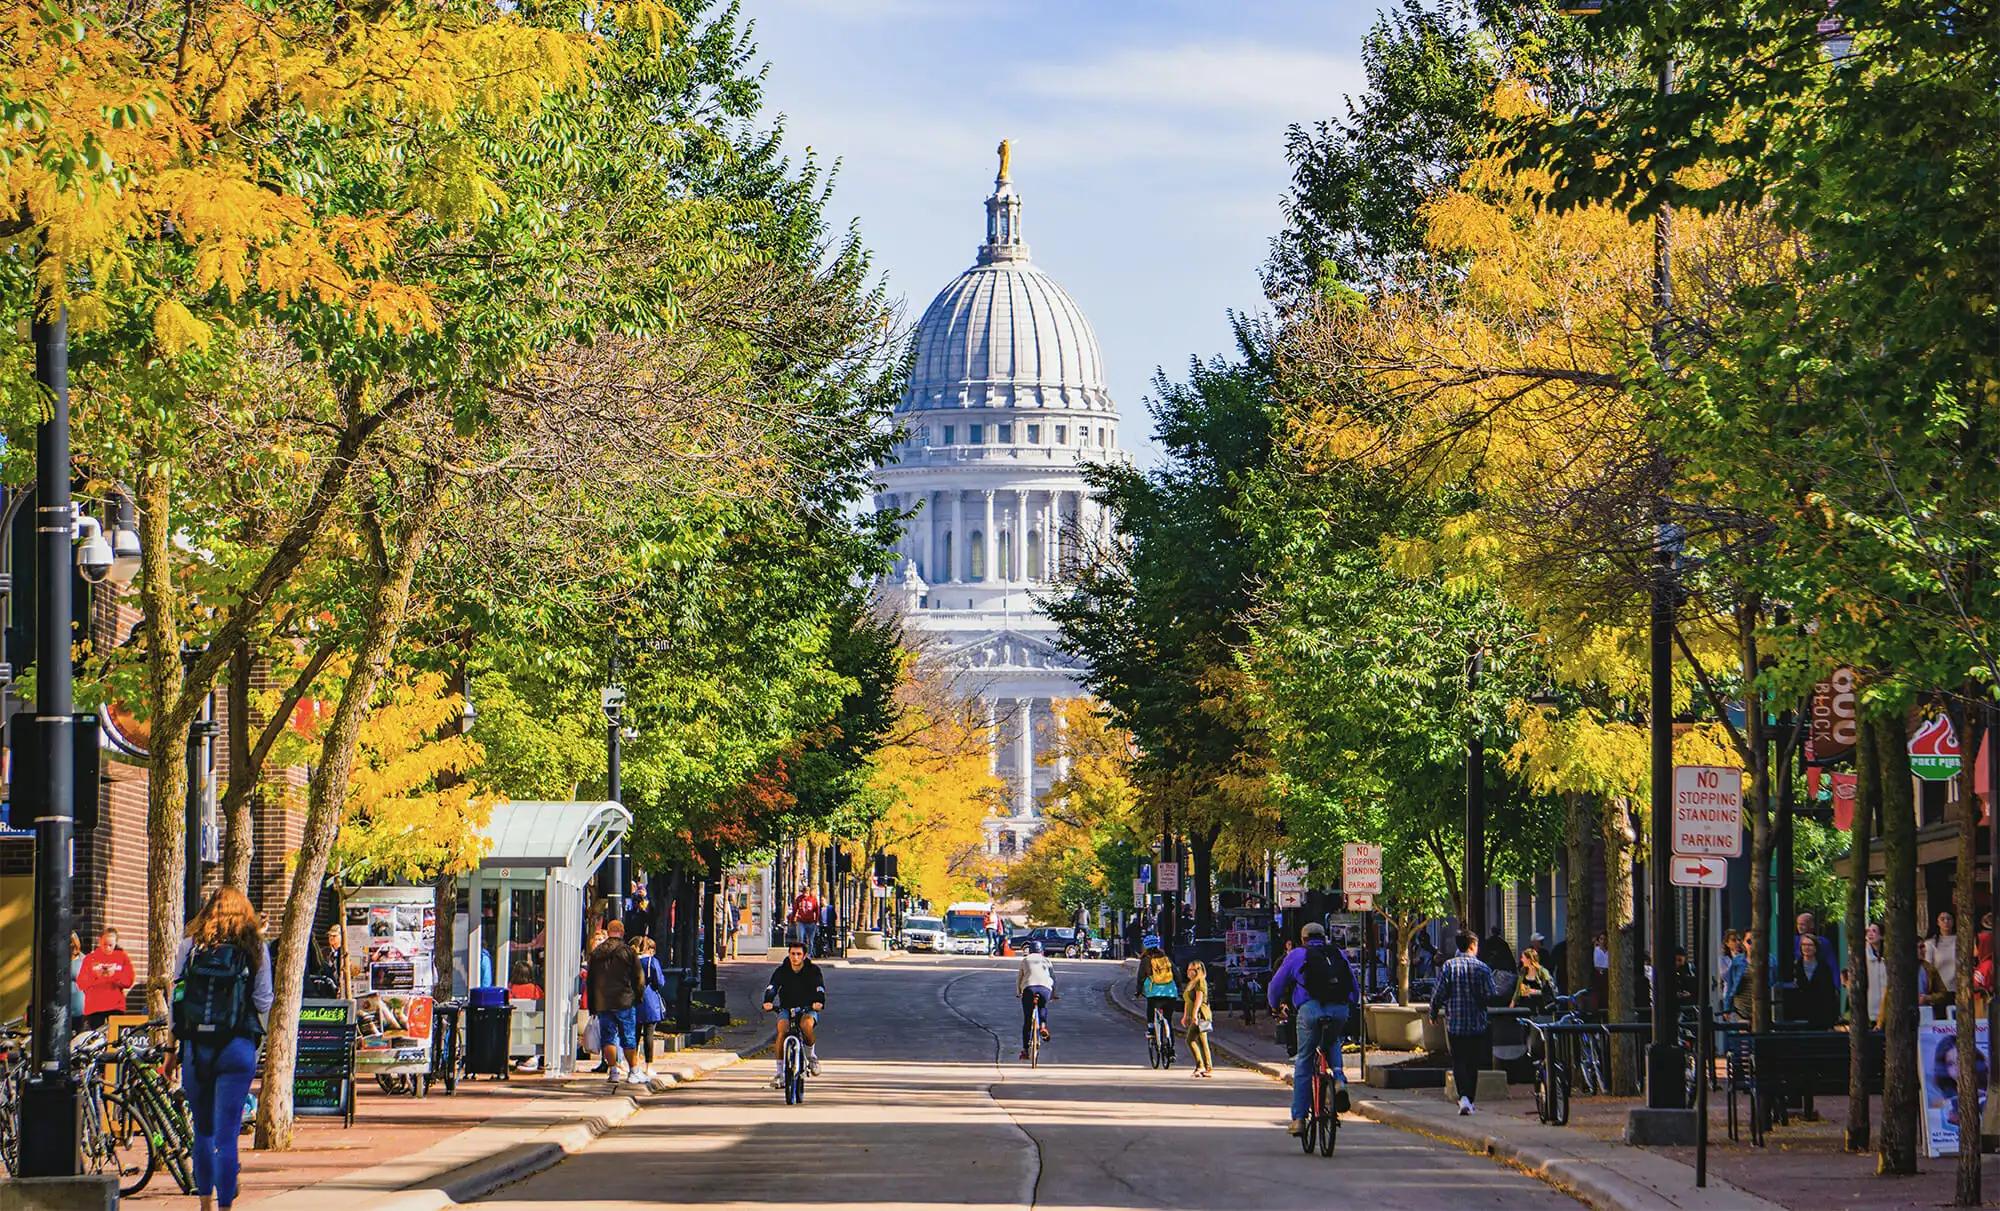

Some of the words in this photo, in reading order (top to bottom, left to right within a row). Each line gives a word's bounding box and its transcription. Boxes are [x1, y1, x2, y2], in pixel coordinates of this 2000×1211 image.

[1814, 682, 1831, 742] BLOCK
[1697, 771, 1718, 788] NO
[1679, 791, 1736, 806] STOPPING
[1678, 807, 1736, 822] STANDING
[1681, 833, 1732, 847] PARKING
[1356, 846, 1368, 857] NO
[1346, 857, 1378, 866] STOPPING
[1346, 866, 1379, 875] STANDING
[1348, 881, 1377, 889] PARKING
